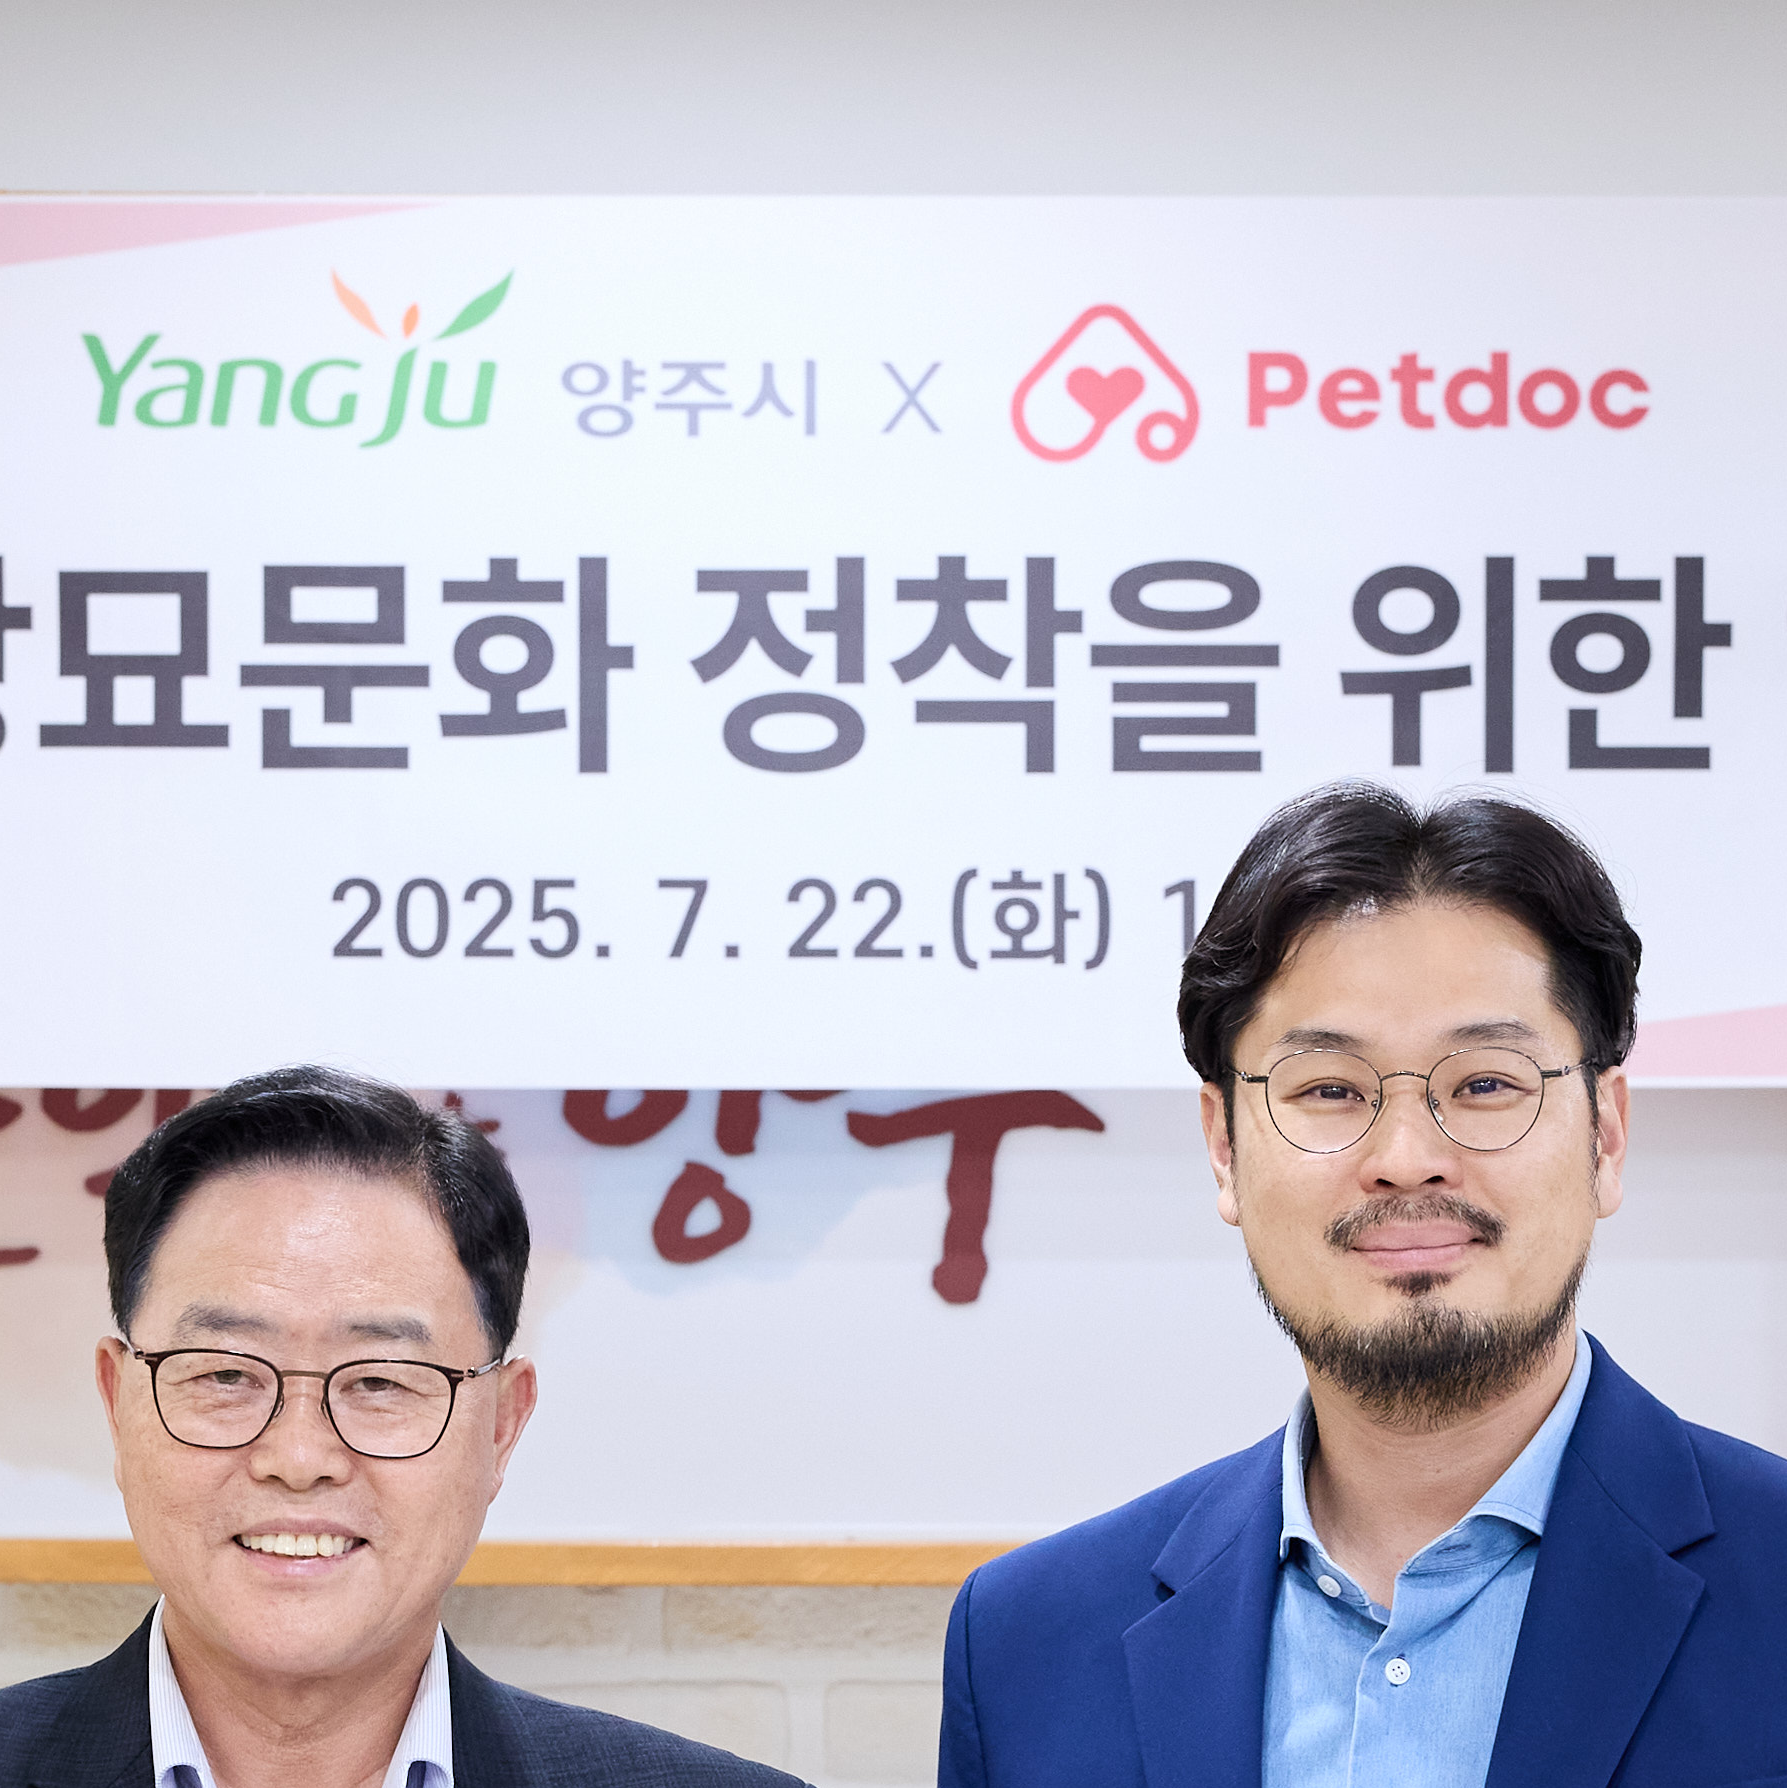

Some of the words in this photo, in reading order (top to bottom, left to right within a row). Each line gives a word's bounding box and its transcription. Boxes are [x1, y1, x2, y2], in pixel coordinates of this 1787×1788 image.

[561, 359, 816, 438] 양주시
[1249, 352, 1649, 430] Petdoc
[691, 556, 1280, 773] 정착을
[1340, 556, 1732, 773] 위한
[332, 878, 609, 959] 2025.
[658, 879, 739, 958] 7.
[787, 868, 1110, 970] 22.(화)
